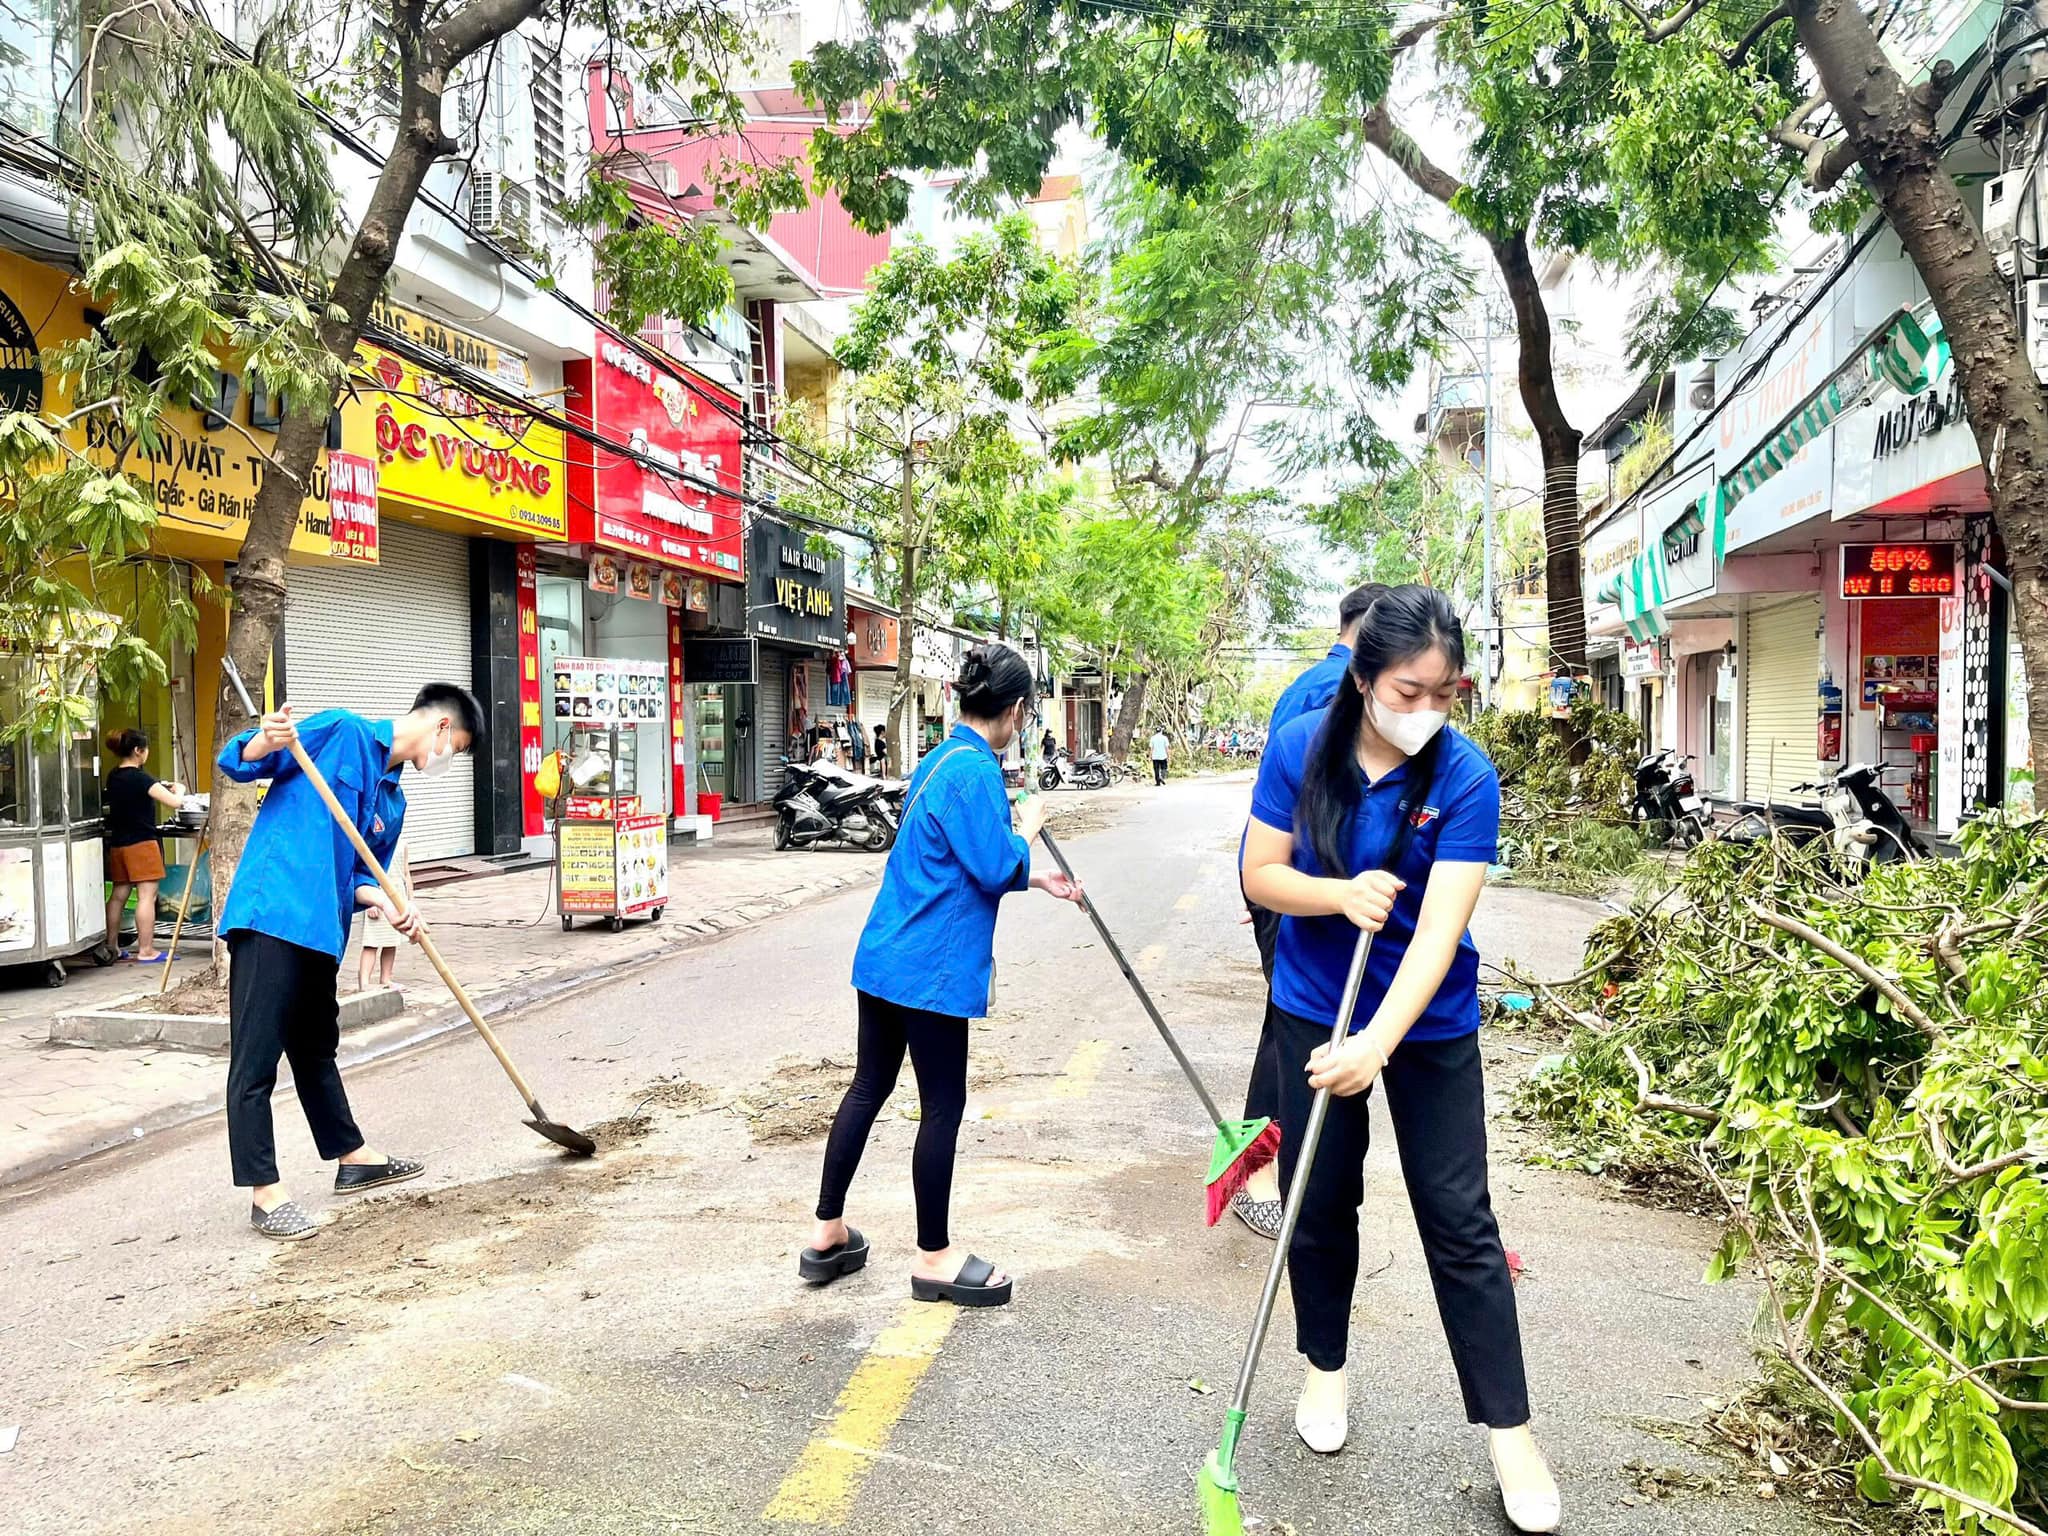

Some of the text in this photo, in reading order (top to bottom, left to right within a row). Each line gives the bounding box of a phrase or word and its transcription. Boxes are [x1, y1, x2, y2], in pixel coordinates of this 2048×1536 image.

[182, 436, 225, 481] VẶT
[199, 488, 215, 513] Gà
[218, 492, 241, 518] Rán
[782, 545, 801, 568] HAIR
[1869, 549, 1932, 572] 50%
[776, 576, 830, 617] VIỆT ANH
